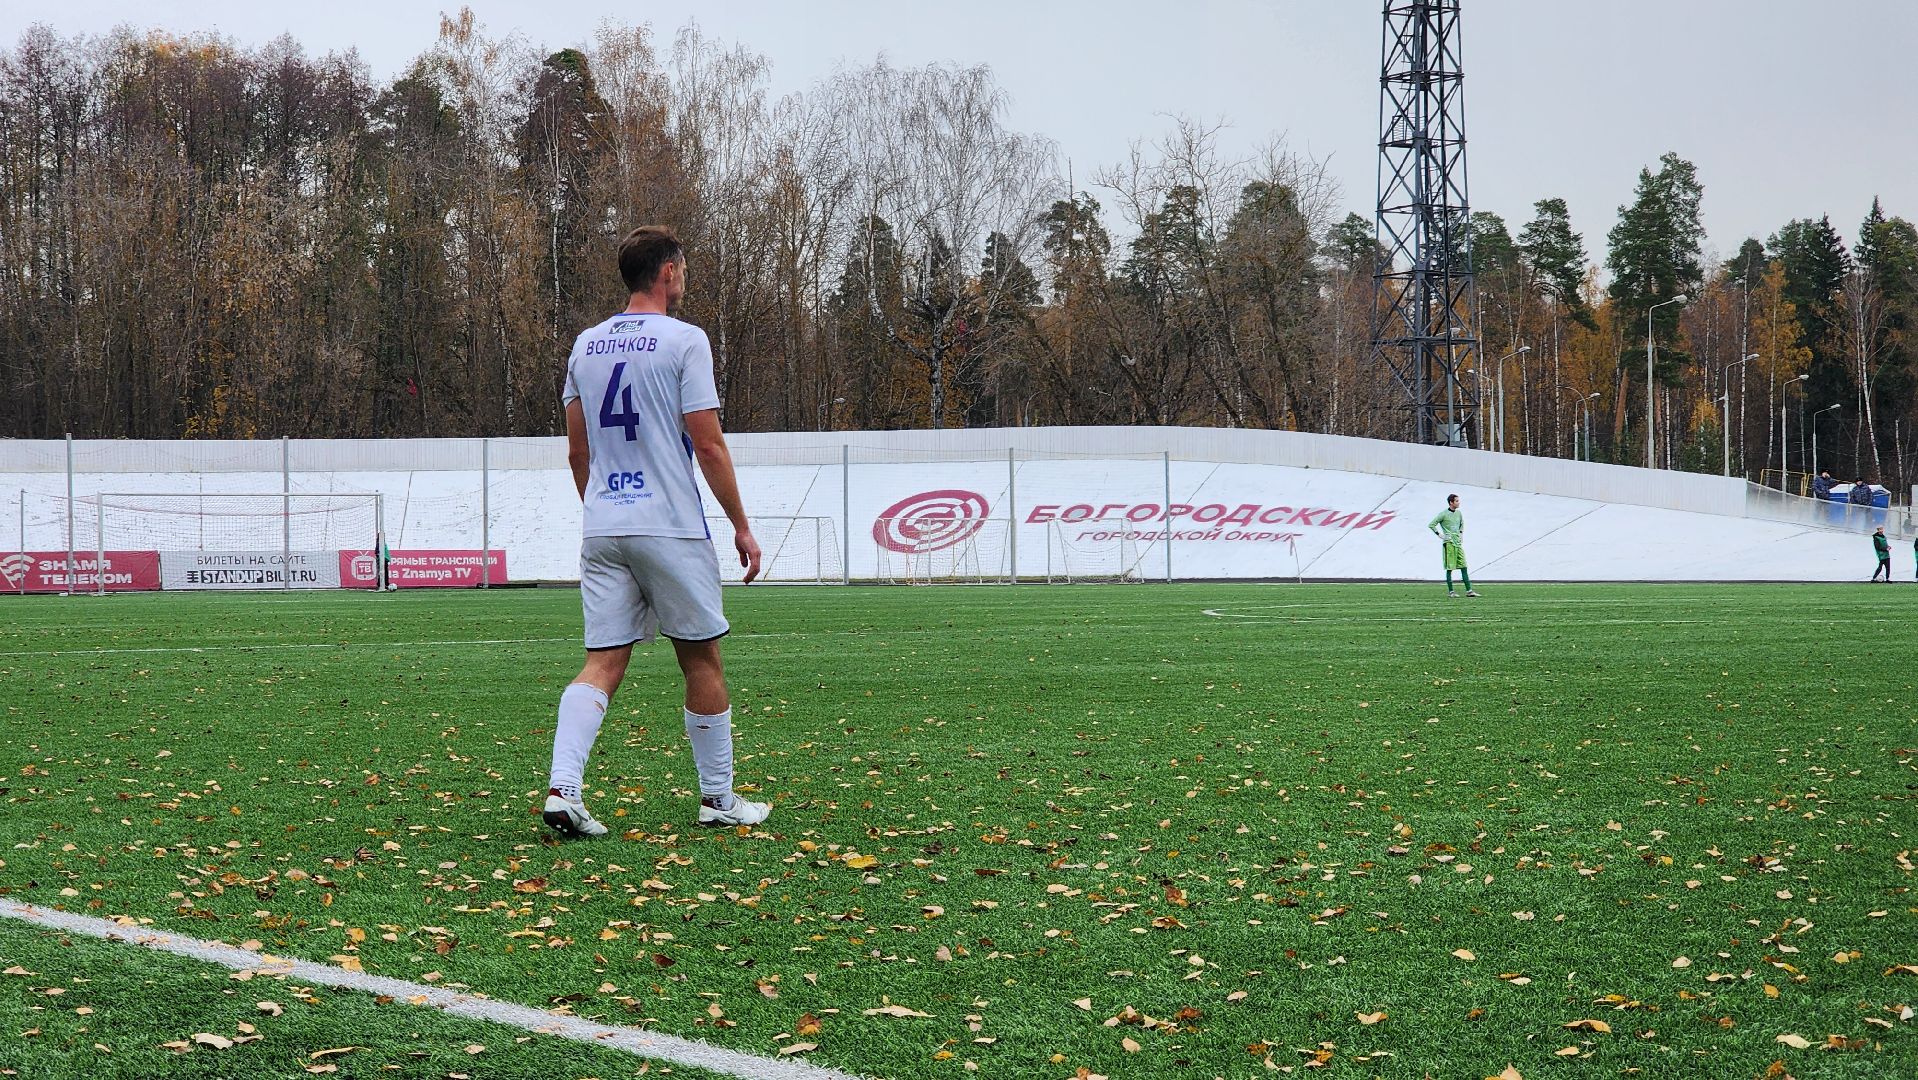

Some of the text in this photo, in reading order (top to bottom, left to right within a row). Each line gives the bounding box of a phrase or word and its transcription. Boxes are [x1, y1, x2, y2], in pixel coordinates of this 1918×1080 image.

[586, 336, 657, 355] ВОЛЧКОВ
[599, 361, 639, 441] 4
[608, 471, 644, 491] GPS
[1025, 504, 1396, 530] БОГОРОДСКИЙ
[1075, 528, 1303, 541] ГОРОДСКОЙ ОКРУГ
[197, 555, 245, 565] БИЛЕТЫ
[249, 555, 266, 565] НА
[388, 557, 428, 566] РЯМЫЕ
[40, 574, 133, 585] ТЕЛЕКОМ
[265, 570, 317, 583] BILT.RU
[402, 568, 452, 581] Znamya
[454, 567, 472, 579] TV
